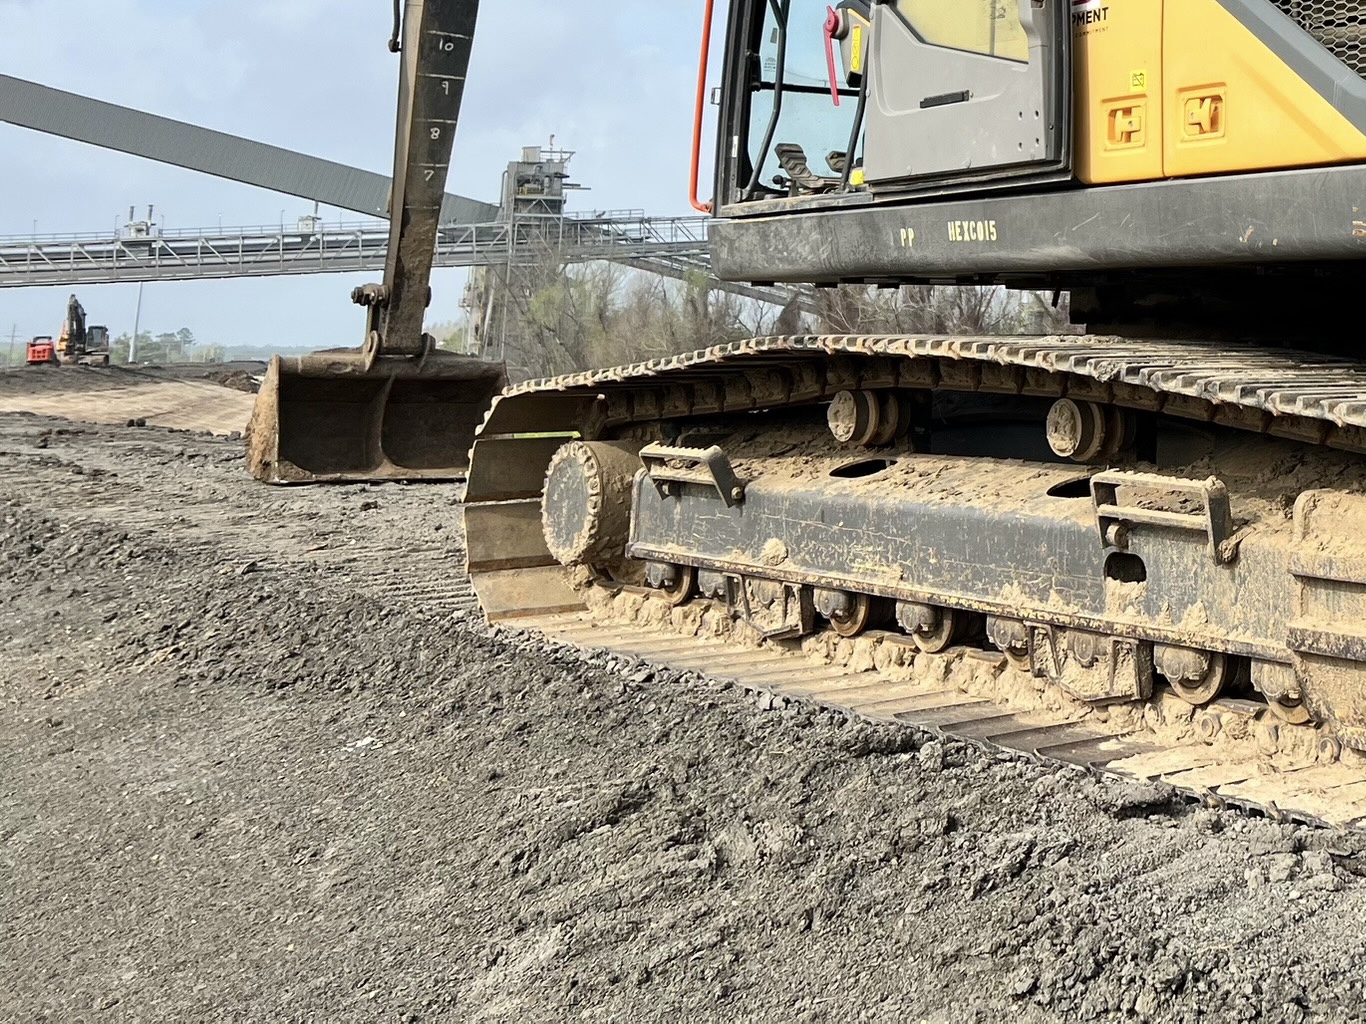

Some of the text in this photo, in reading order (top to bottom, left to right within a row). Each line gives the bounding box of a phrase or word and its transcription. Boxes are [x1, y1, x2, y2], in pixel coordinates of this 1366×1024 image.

[439, 37, 454, 51] 10
[441, 80, 449, 95] 9
[430, 127, 440, 140] 8
[424, 169, 434, 182] 7
[900, 227, 915, 247] PP
